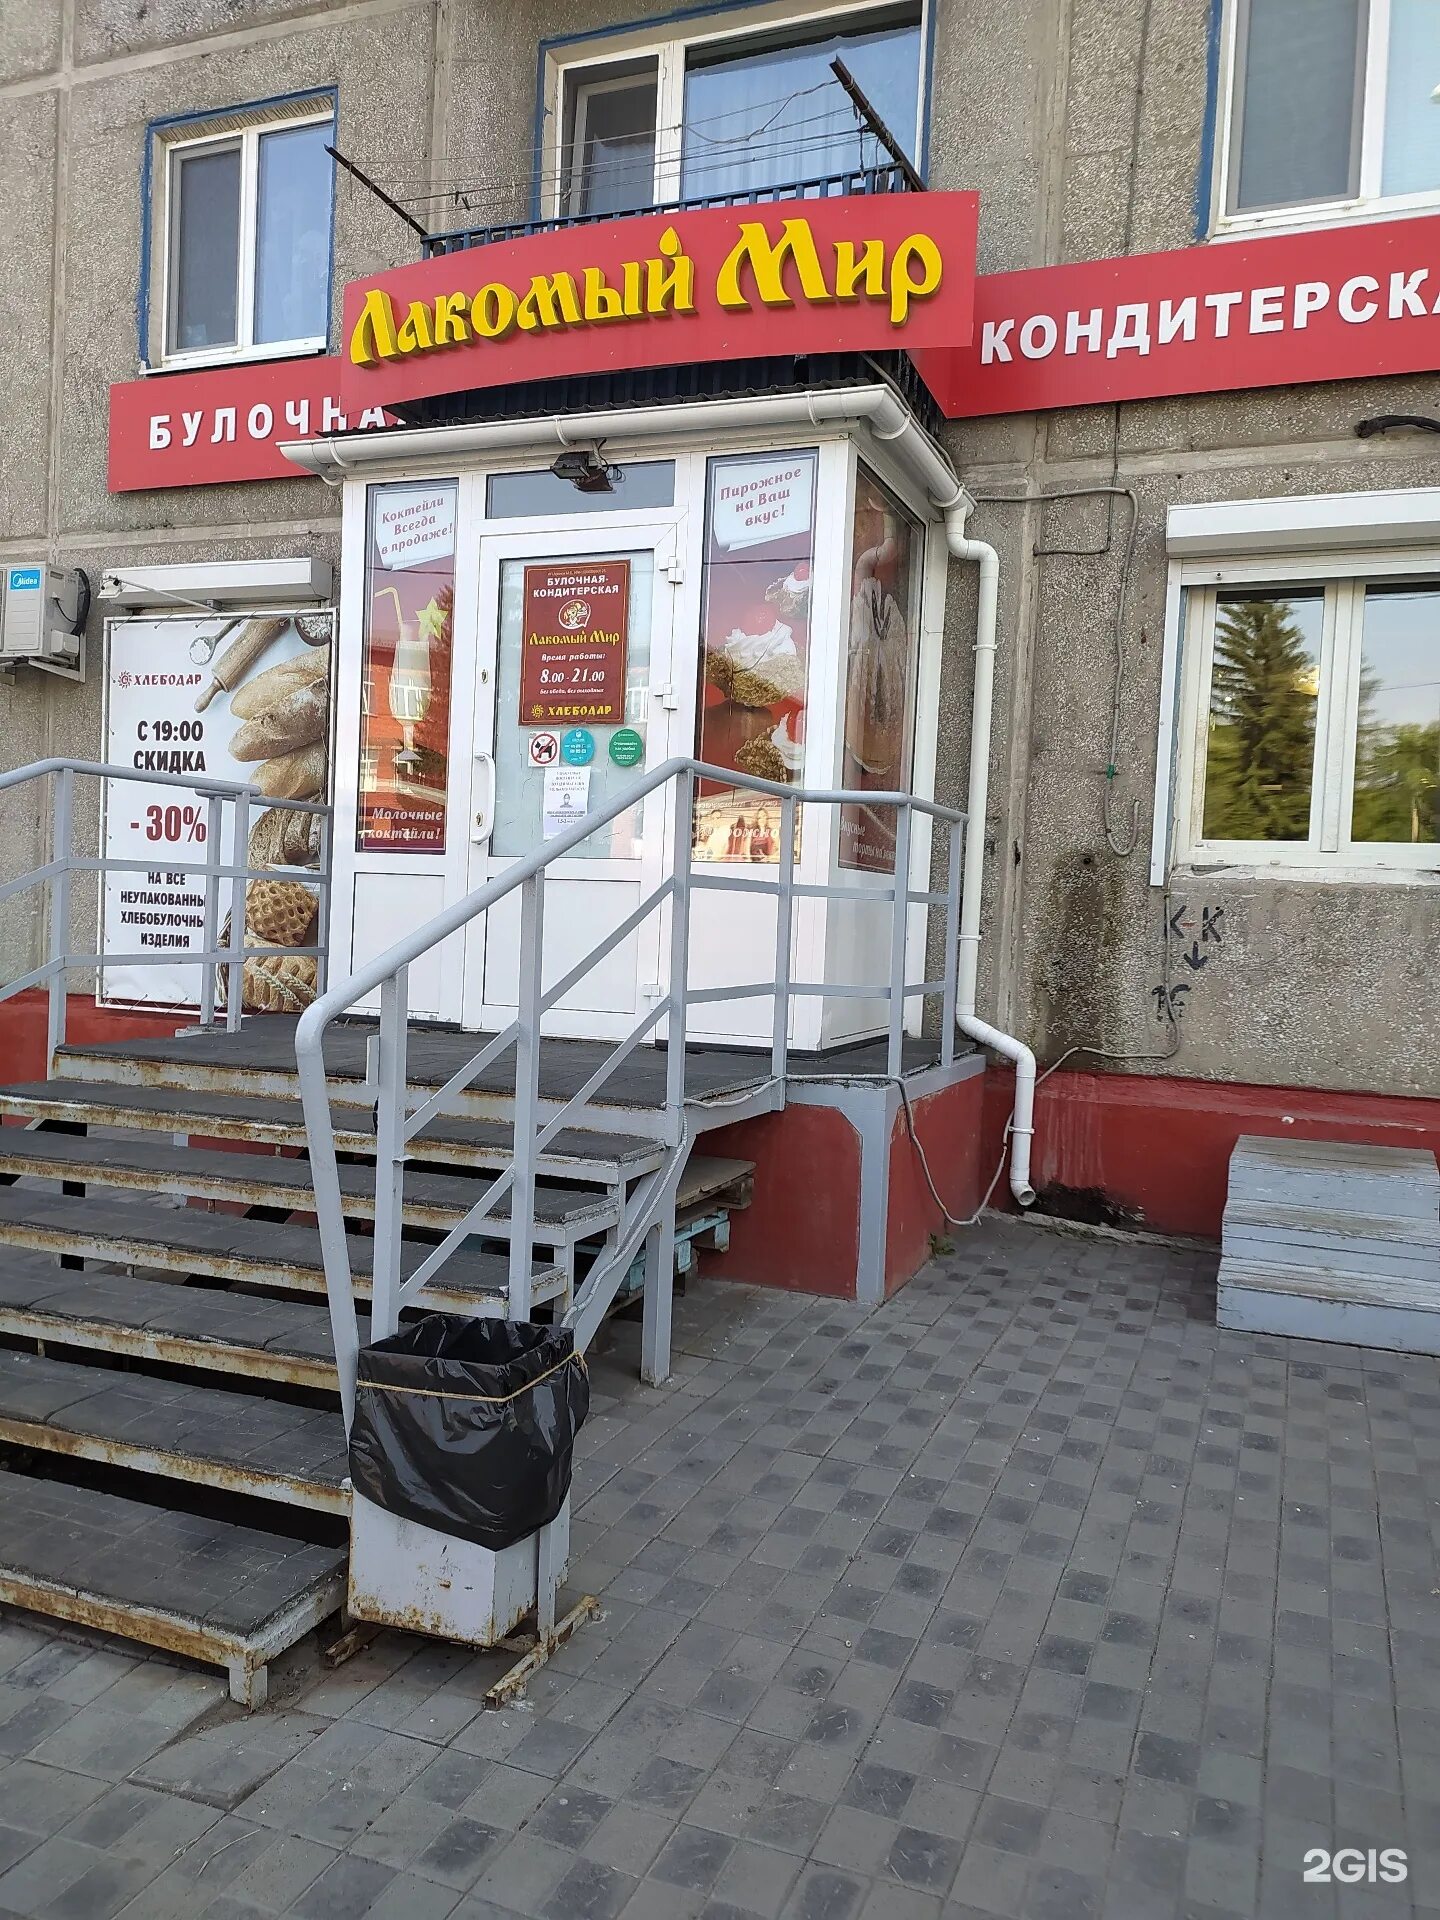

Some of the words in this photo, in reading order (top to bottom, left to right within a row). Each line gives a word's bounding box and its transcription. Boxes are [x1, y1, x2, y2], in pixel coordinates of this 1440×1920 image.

[350, 226, 696, 366] Лакомый
[716, 218, 943, 325] Мир
[981, 268, 1440, 365] КОНДИТЕРСК
[149, 396, 406, 450] БУЛОЧНА
[720, 468, 801, 500] Пирожное
[382, 497, 444, 524] Коктейли
[736, 500, 753, 512] на
[758, 489, 790, 506] Ваш
[394, 515, 436, 535] Всегда
[745, 504, 785, 526] вкус!
[381, 546, 389, 555] в
[391, 523, 453, 552] продаже!
[15, 576, 38, 587] Midea
[533, 585, 619, 598] КОНДИТЕРСКАЯ
[529, 631, 587, 645] Лакомый
[589, 630, 620, 646] Мир
[133, 674, 202, 687] ХЛЕБОДАР
[540, 669, 565, 683] 8.00
[571, 668, 605, 683] 21.00
[547, 705, 612, 717] ХЛЕБОДАР
[137, 720, 148, 741] С
[152, 720, 204, 741] 19:00
[133, 750, 207, 774] СКИДКА
[371, 807, 443, 820] Молочные
[146, 805, 207, 843] 30%
[148, 872, 162, 885] НА
[166, 873, 186, 886] ВСЕ
[120, 891, 206, 907] НЕУПАКОВАННЫ
[140, 932, 190, 948] ИЗДЕЛИЯ
